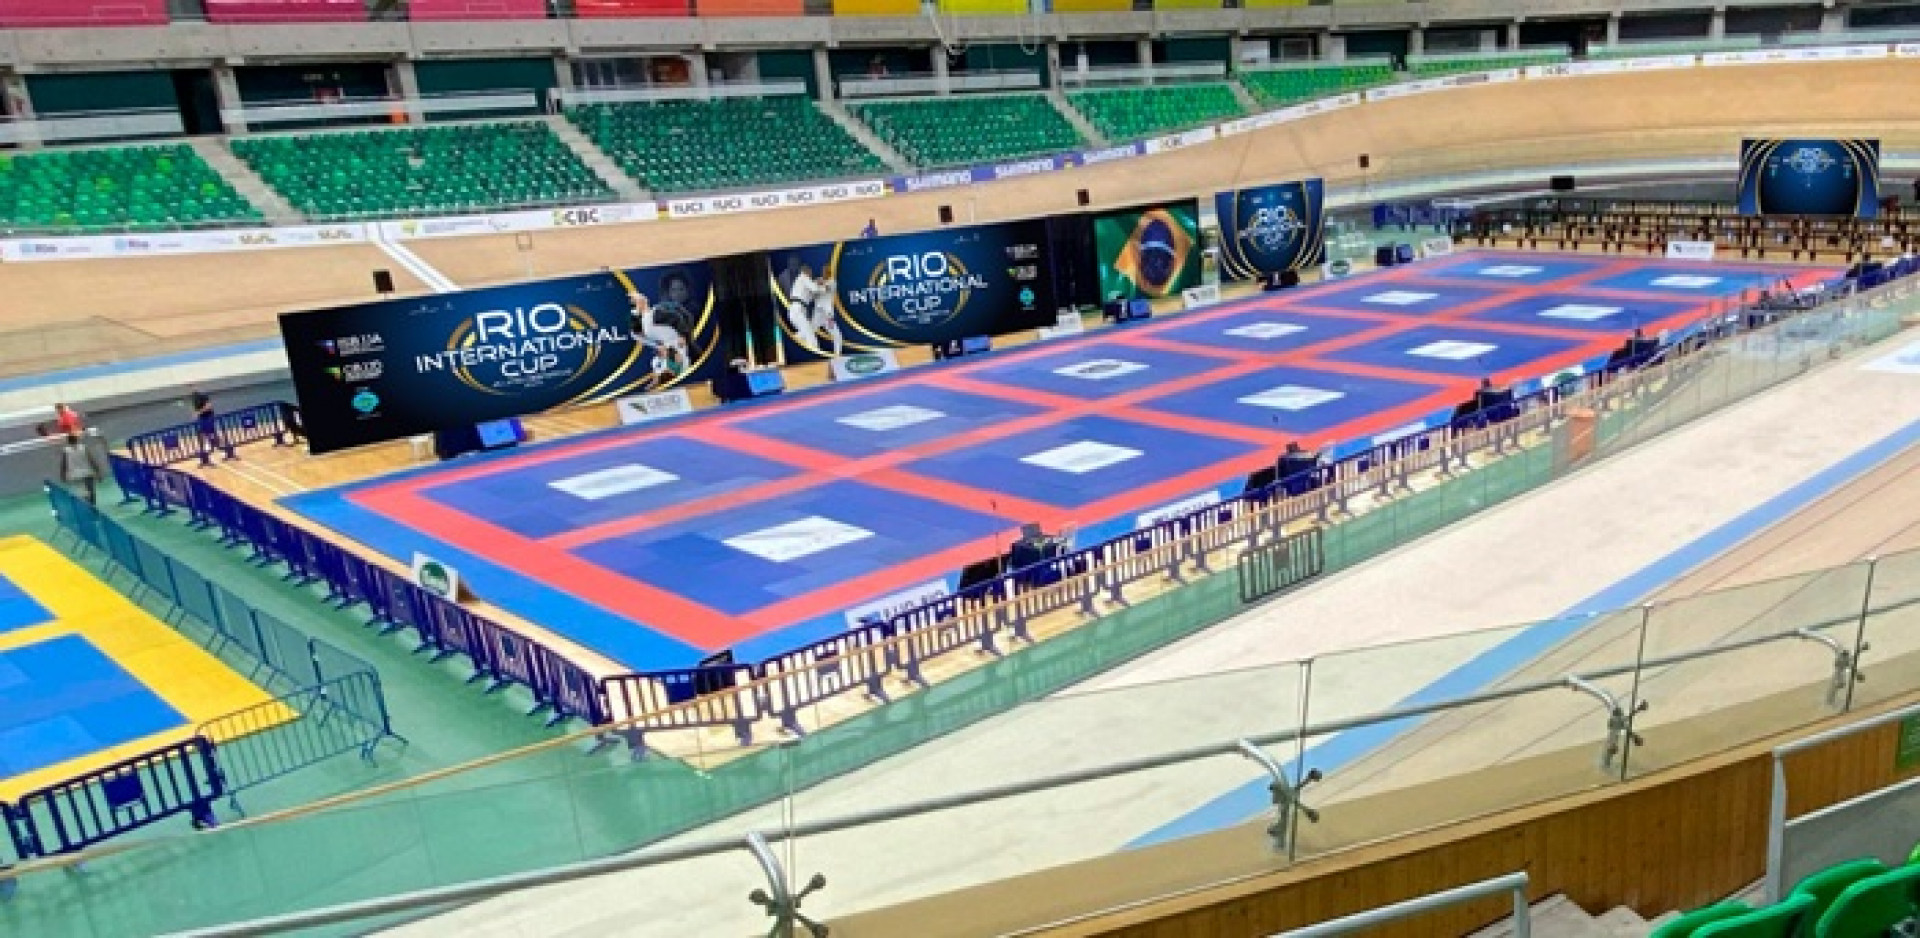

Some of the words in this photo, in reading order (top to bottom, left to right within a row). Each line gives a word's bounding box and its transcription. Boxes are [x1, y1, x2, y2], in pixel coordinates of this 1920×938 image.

[1258, 205, 1287, 223] RIO
[887, 251, 948, 281] RIO
[849, 273, 988, 304] INTERNATIONAL
[902, 295, 942, 314] CUP
[476, 303, 566, 343] RIO
[415, 325, 628, 373] INTERNATIONAL
[501, 353, 559, 377] CUP
